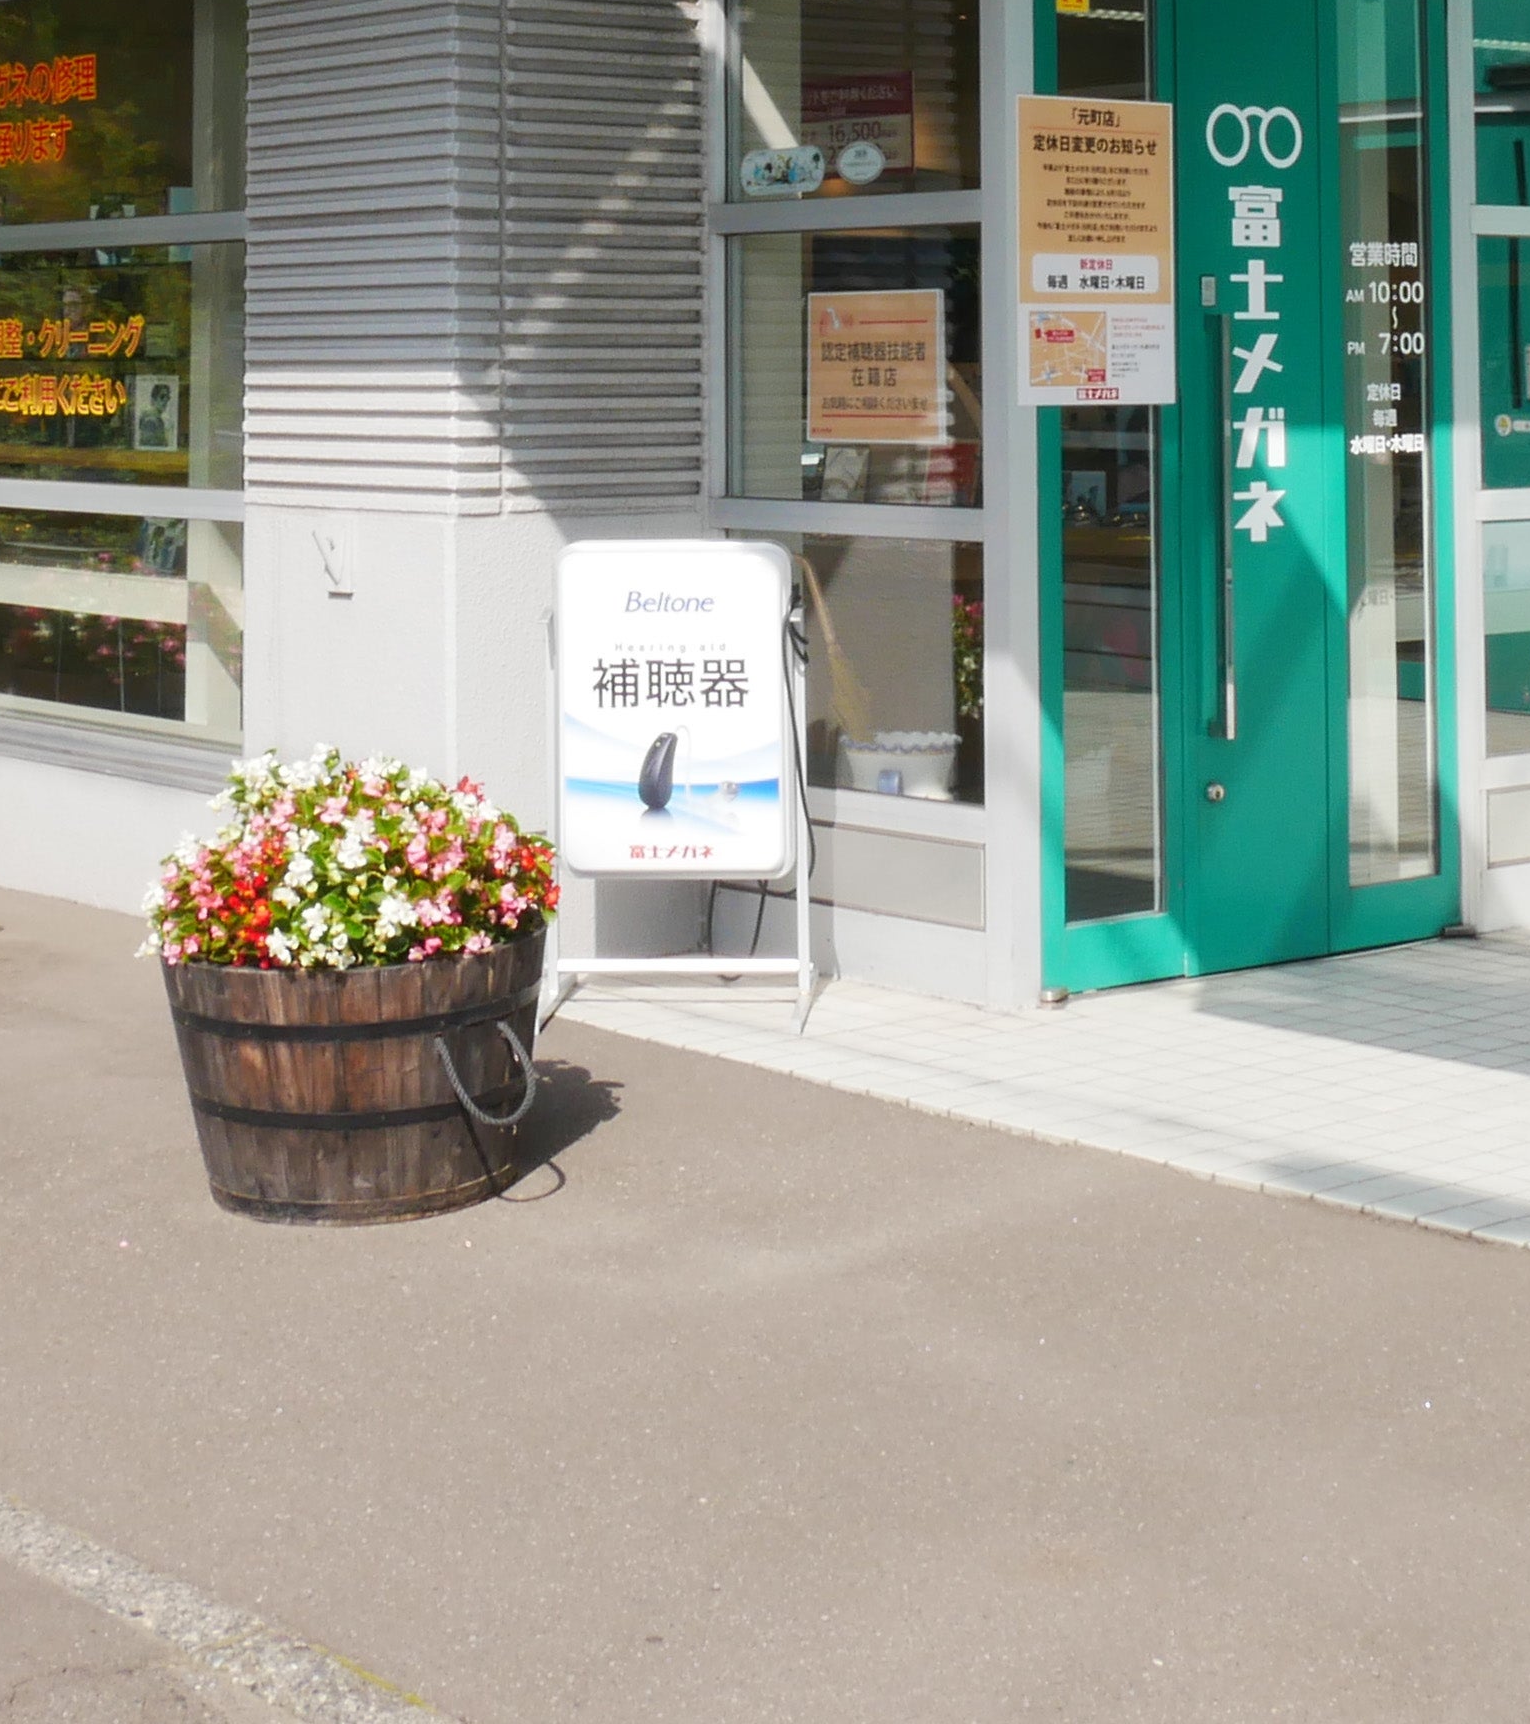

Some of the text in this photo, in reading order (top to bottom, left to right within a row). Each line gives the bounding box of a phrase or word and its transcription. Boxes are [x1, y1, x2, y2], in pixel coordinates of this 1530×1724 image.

[1072, 107, 1121, 128] 「元町店」
[1032, 134, 1158, 156] 定休日変更のお知らせ
[1349, 242, 1418, 268] 営業時間
[1047, 275, 1068, 290] 毎週
[1345, 280, 1425, 304] AM 10:00
[821, 342, 927, 362] 認定補聴器技能者
[1346, 331, 1426, 356] PM 7:00
[1227, 185, 1286, 543] 富士メガネ
[1366, 383, 1402, 402] 定休日
[624, 590, 715, 614] Beltone
[614, 641, 728, 655] Hearing aid
[592, 657, 750, 709] 補聴器
[629, 844, 715, 861] 富士メガネ
